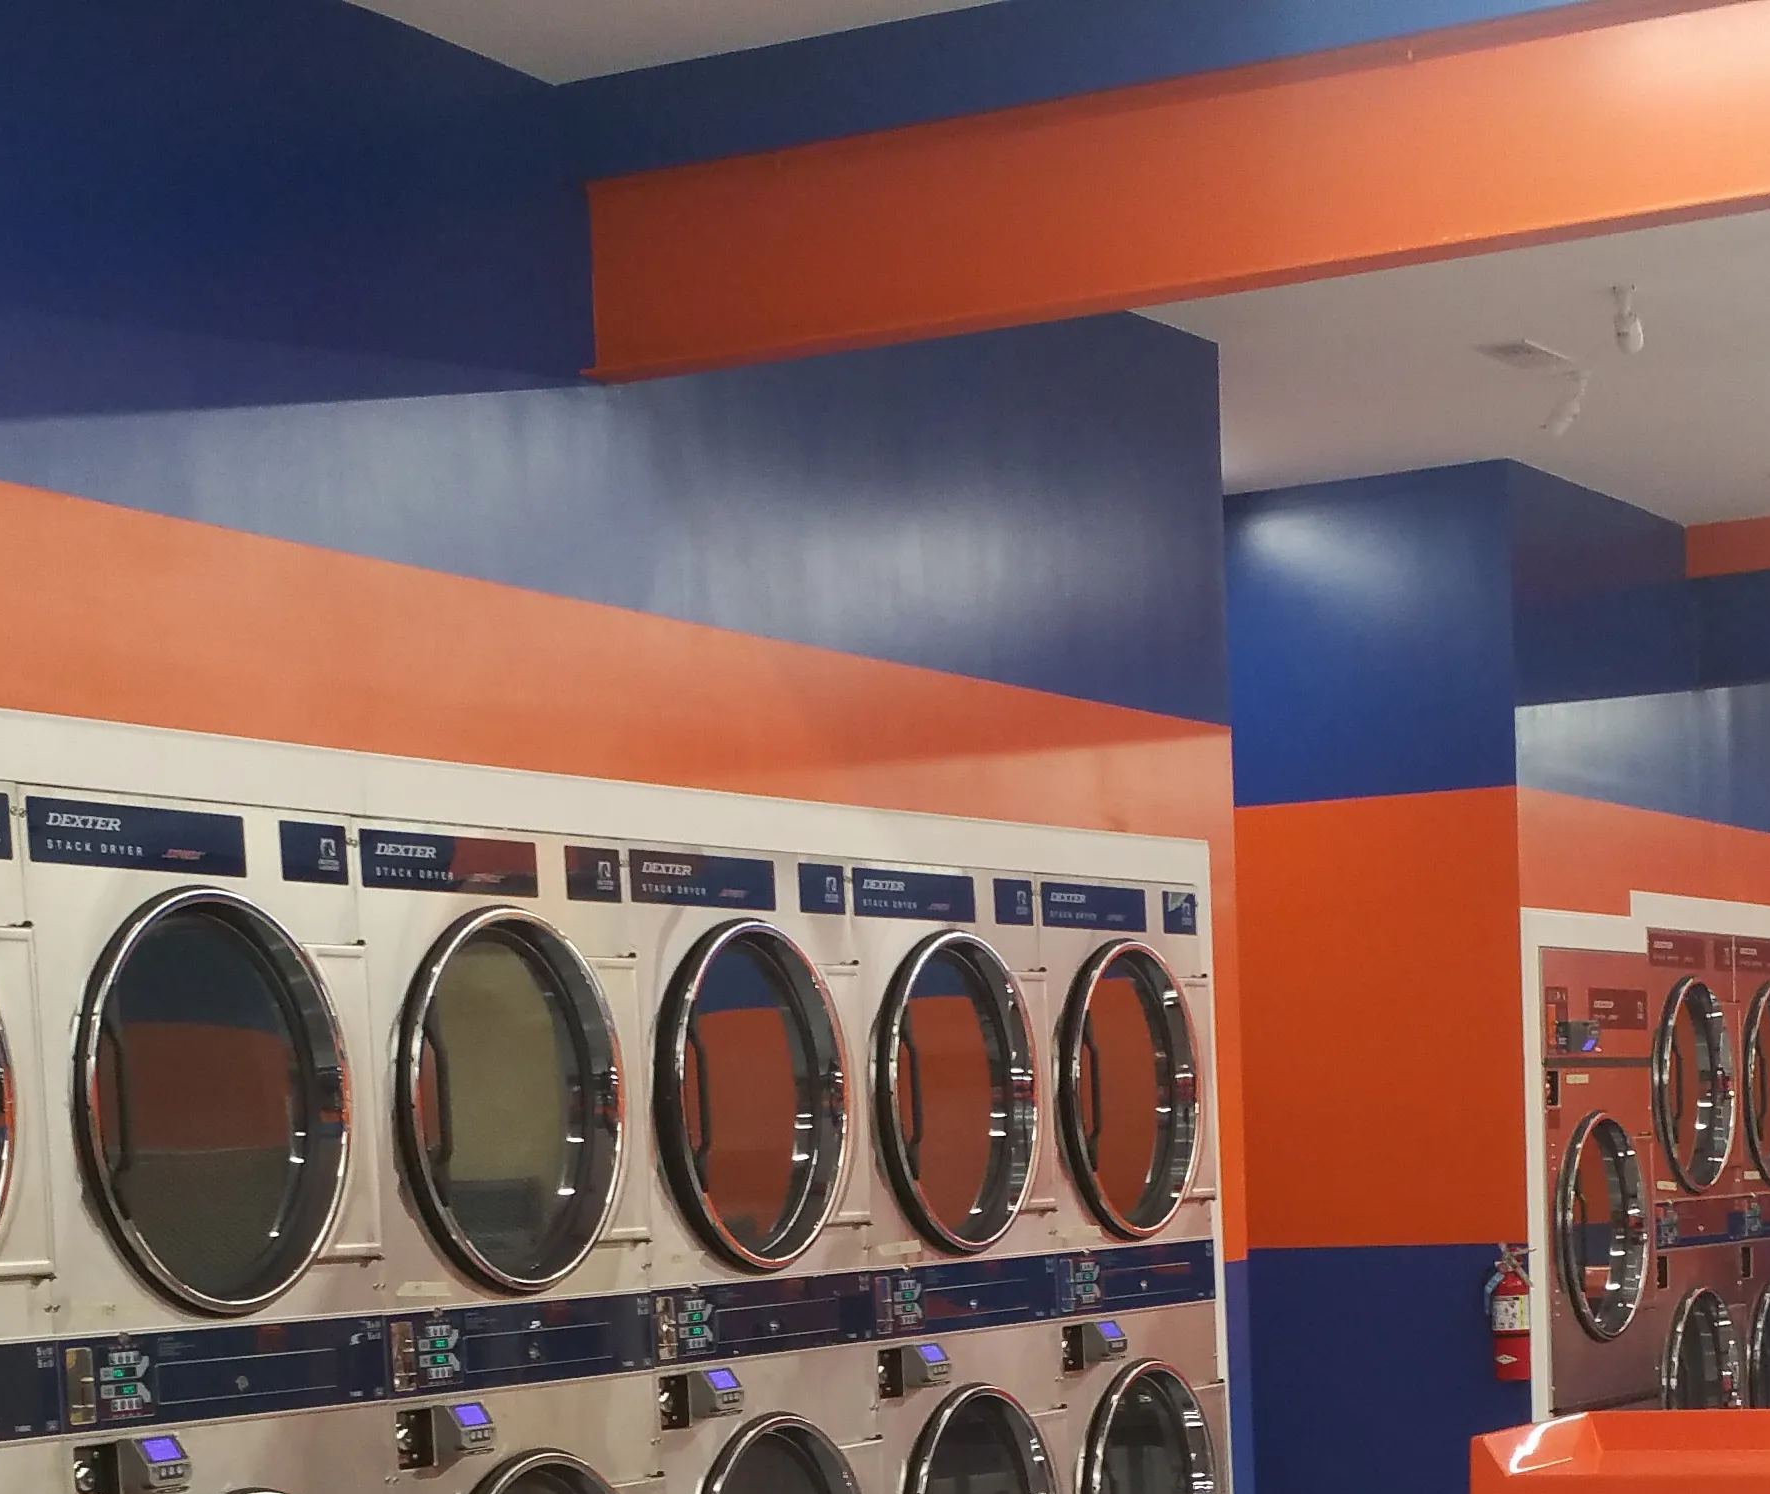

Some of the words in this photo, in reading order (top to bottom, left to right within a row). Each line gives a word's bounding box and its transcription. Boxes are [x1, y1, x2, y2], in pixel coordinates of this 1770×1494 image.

[46, 812, 122, 832] DEXTER
[46, 838, 92, 852] STACK
[100, 843, 145, 857] DRYER
[374, 842, 437, 859] DEXTER
[375, 866, 413, 879] STACK
[641, 861, 693, 876] DEXTER
[862, 878, 906, 892] DEXTER
